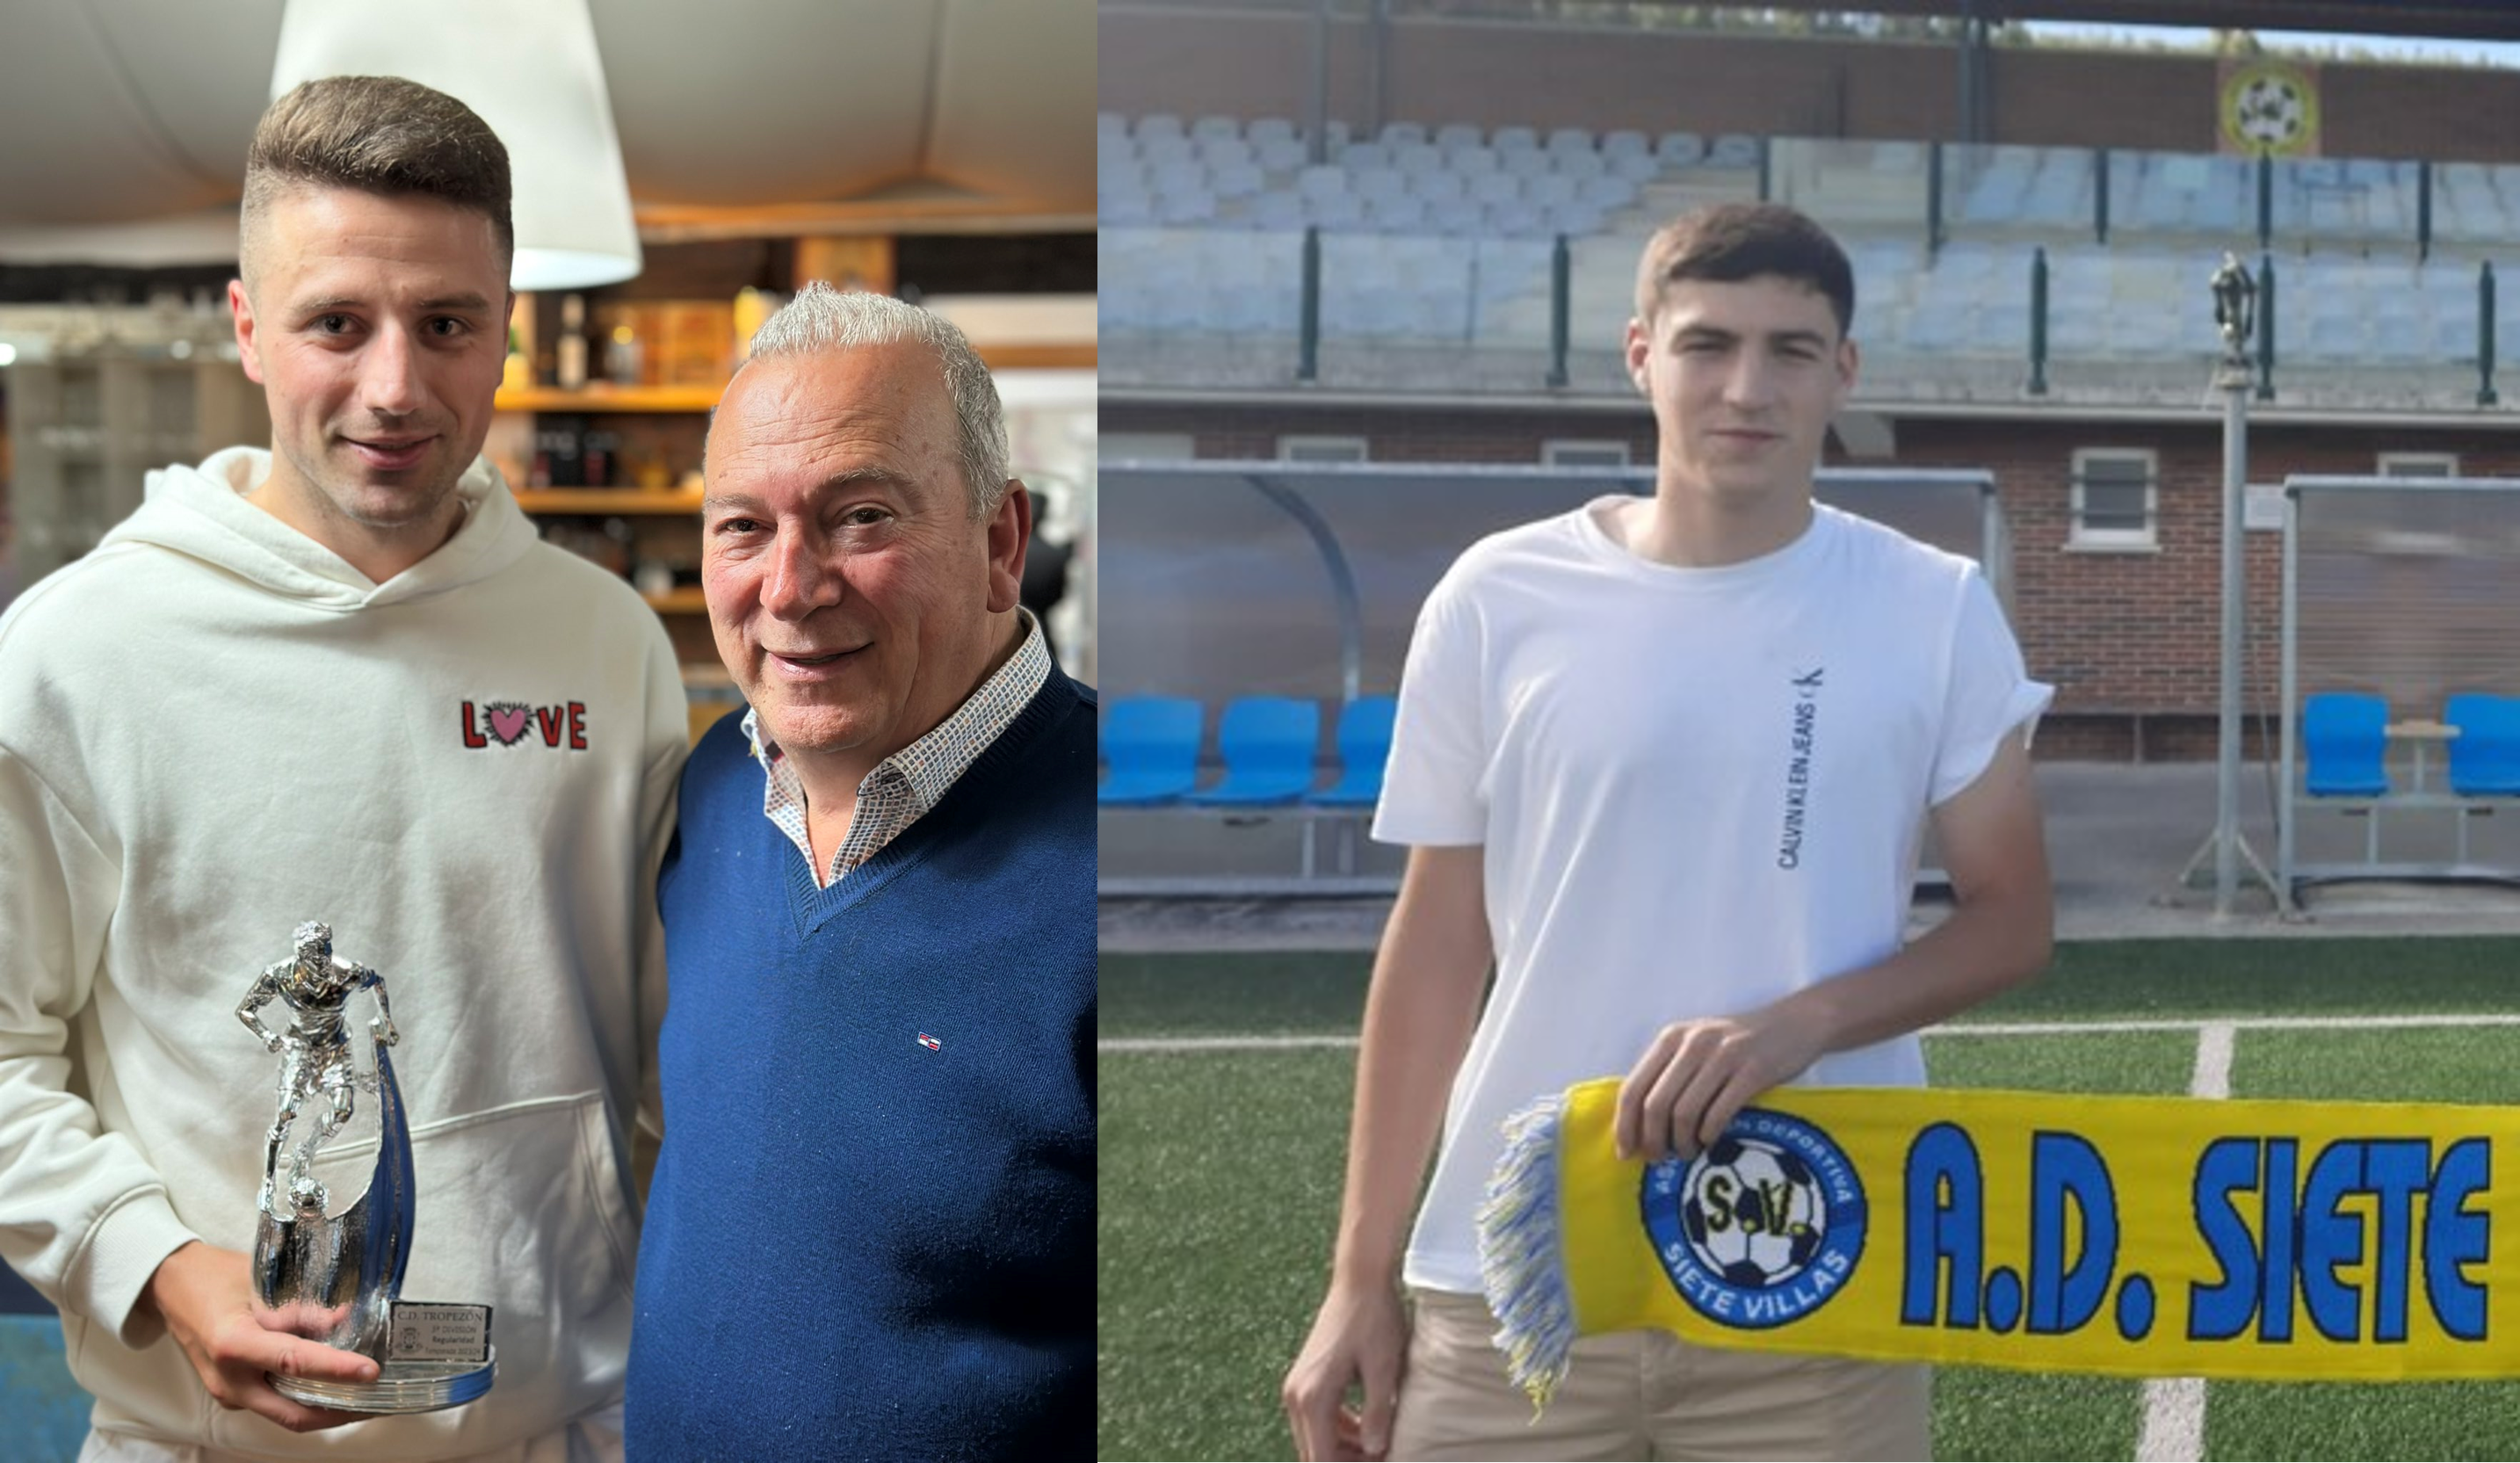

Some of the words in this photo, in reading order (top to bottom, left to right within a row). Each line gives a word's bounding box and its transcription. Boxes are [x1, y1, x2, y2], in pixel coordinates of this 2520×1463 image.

[1792, 703, 1817, 756] JEANS
[1787, 757, 1810, 807] KLEIN
[1777, 809, 1804, 870] CALVIN
[1757, 1119, 1854, 1203] DEPORTIVA
[1706, 1174, 1806, 1237] S.V.
[1901, 1120, 2156, 1342] A.D.
[2186, 1136, 2493, 1343] SIETE
[1664, 1242, 1737, 1315] SIETE
[1744, 1249, 1849, 1319] VILLAS
[397, 1311, 419, 1321] C.D.
[423, 1310, 483, 1322] TROPEZÓN
[432, 1335, 474, 1344] Regularidad
